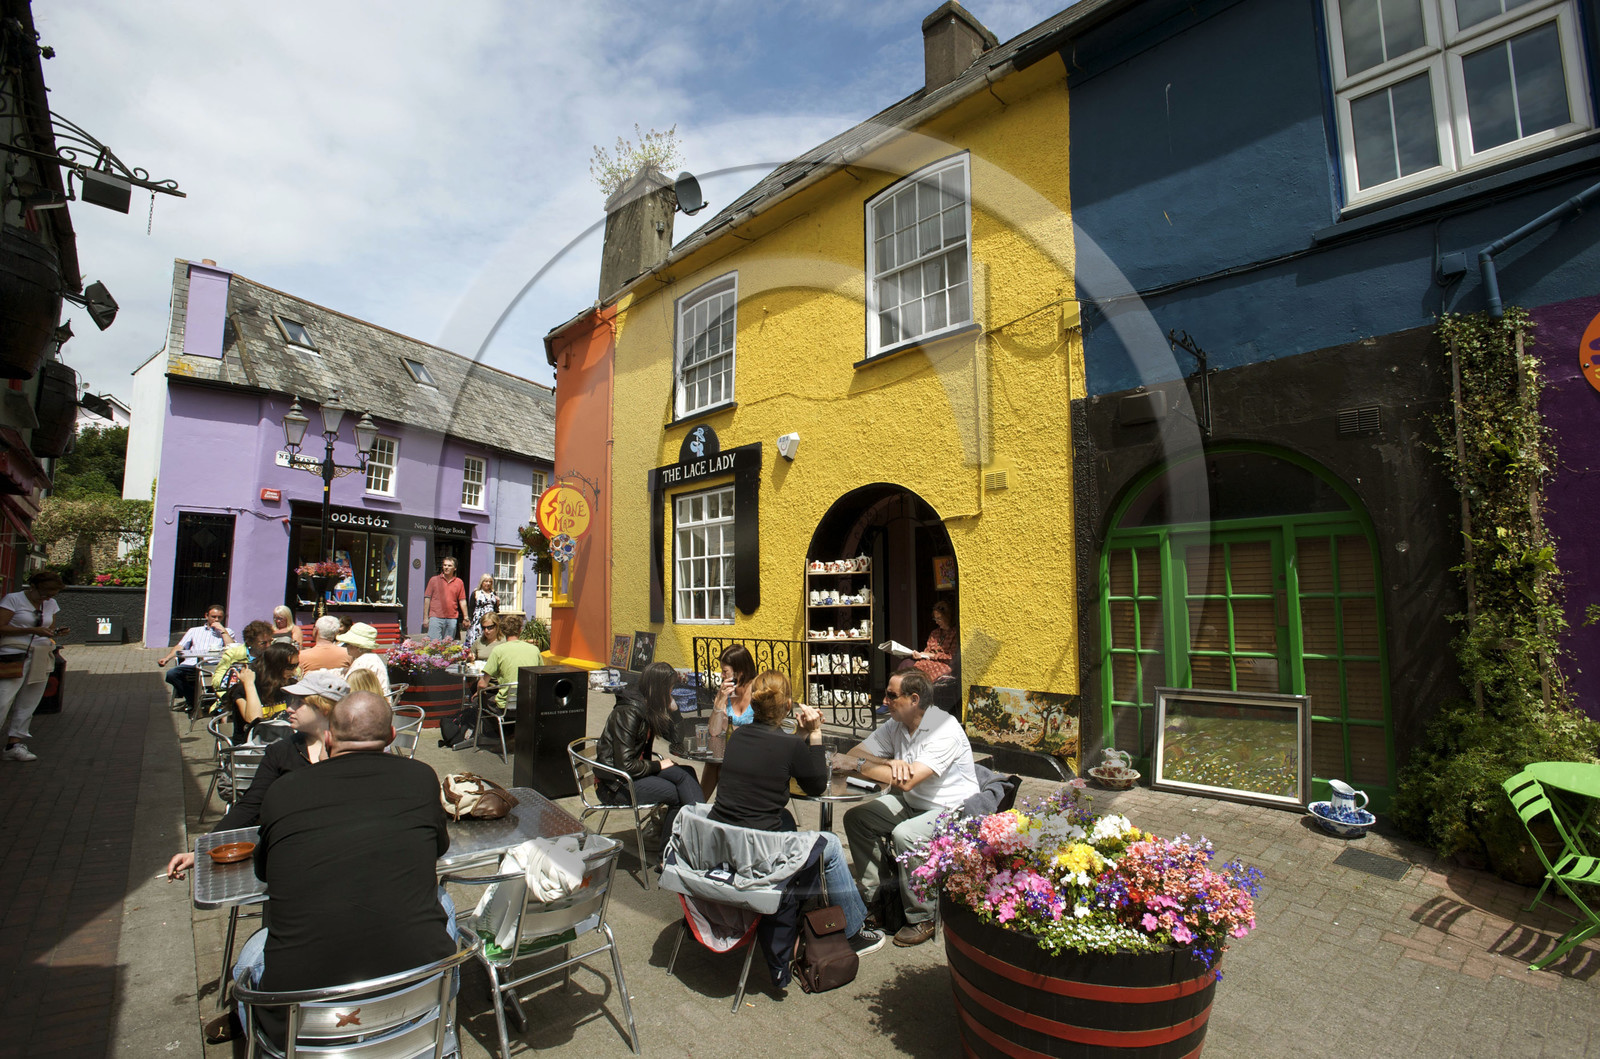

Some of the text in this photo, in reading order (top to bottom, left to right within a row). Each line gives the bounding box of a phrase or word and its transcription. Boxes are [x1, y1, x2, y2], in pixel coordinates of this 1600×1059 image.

[278, 453, 316, 463] NEMANS
[662, 453, 736, 483] THE LACE LADY
[545, 489, 586, 526] STONE
[325, 511, 390, 528] ookstór
[413, 522, 427, 530] New
[434, 525, 452, 534] Vintage
